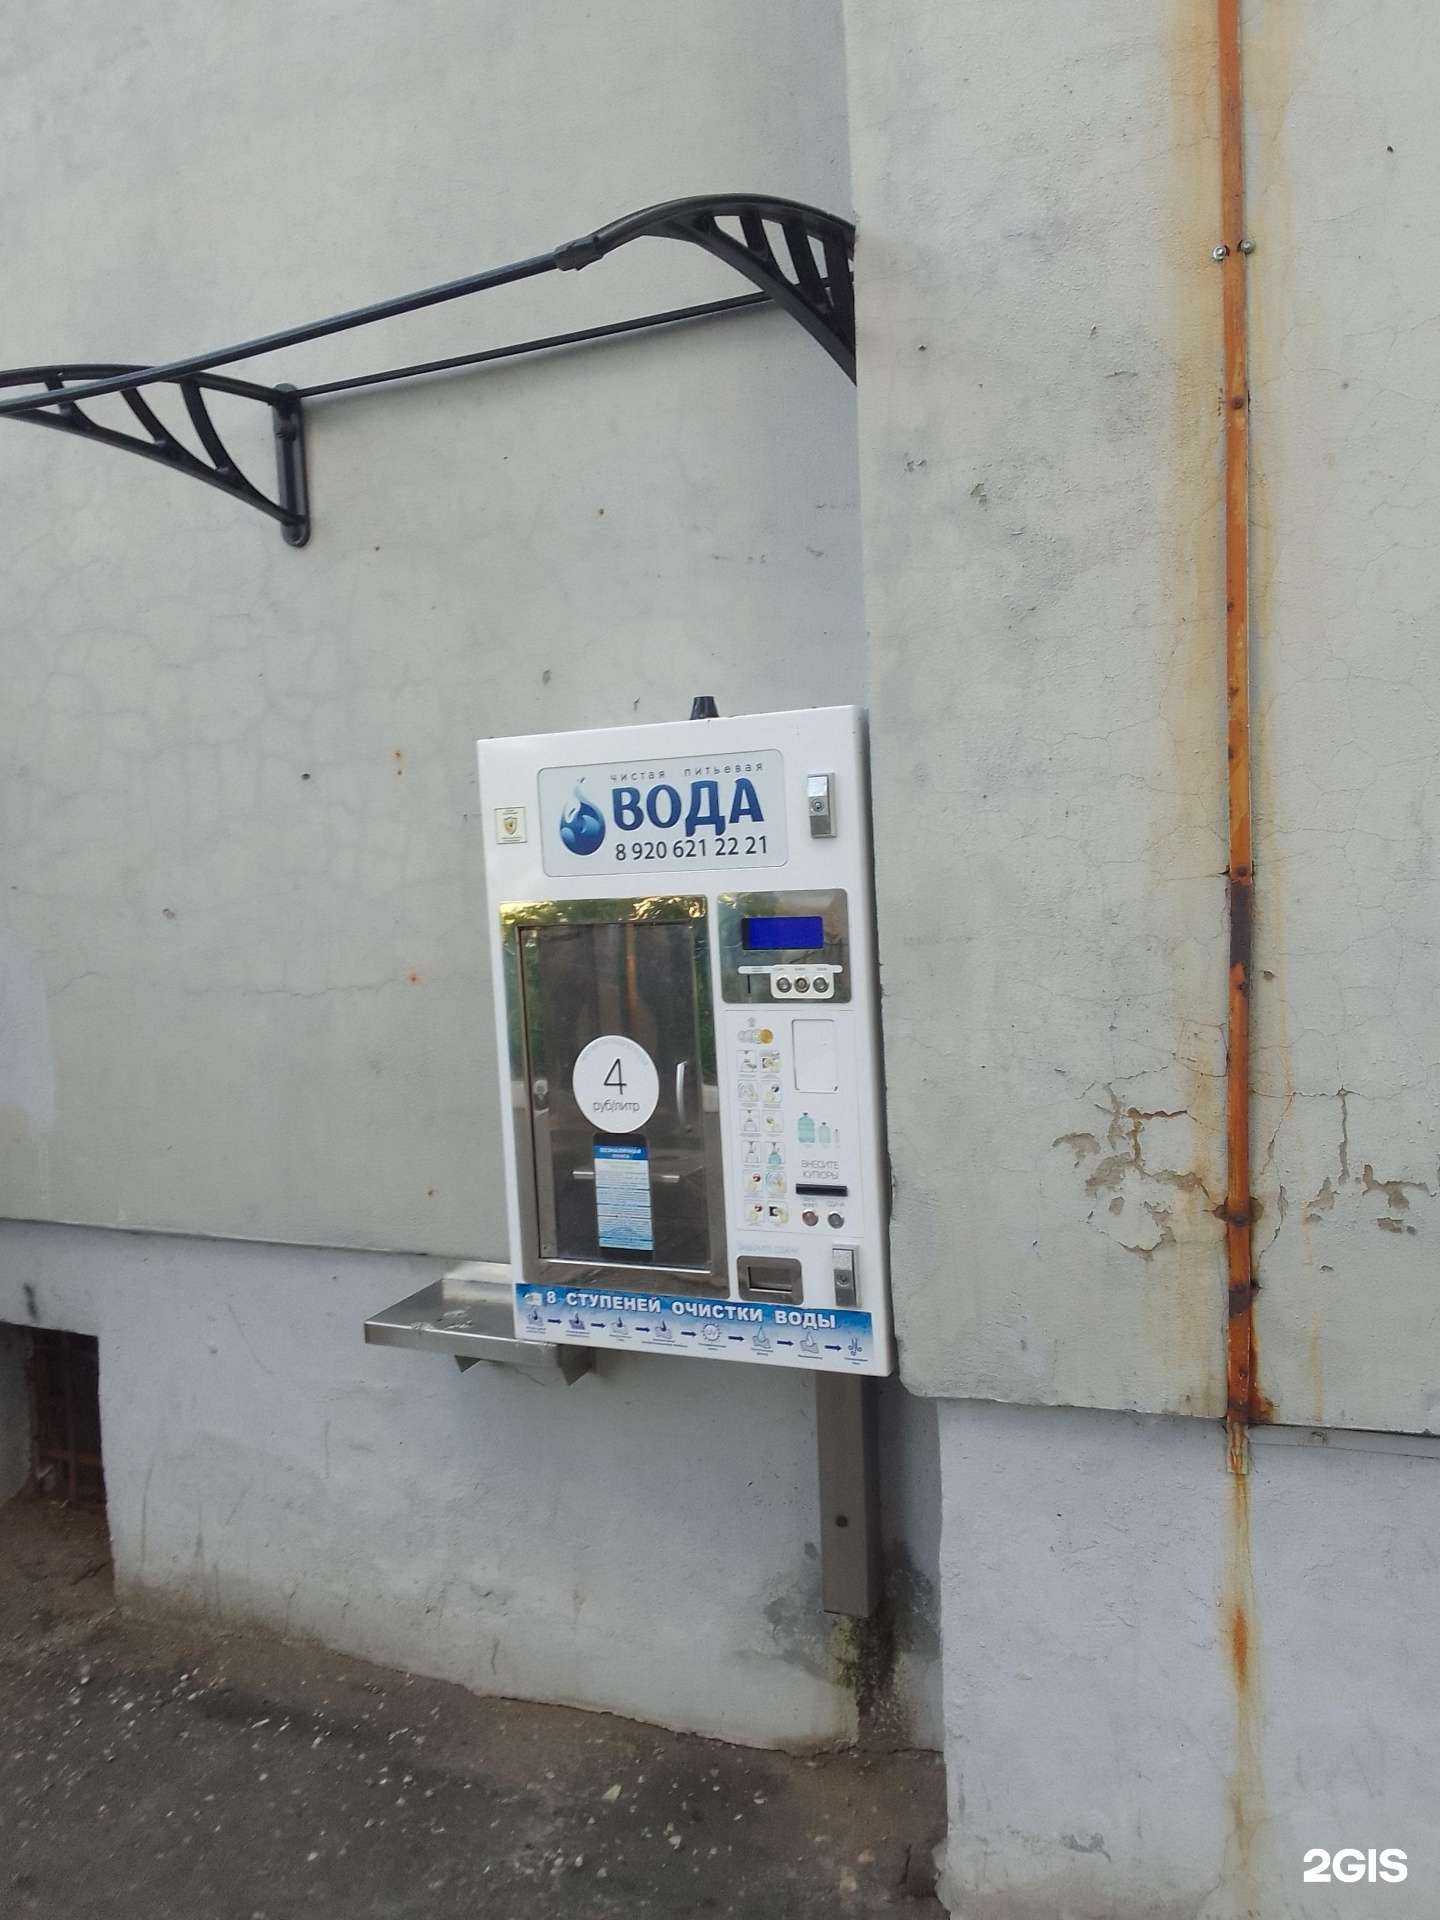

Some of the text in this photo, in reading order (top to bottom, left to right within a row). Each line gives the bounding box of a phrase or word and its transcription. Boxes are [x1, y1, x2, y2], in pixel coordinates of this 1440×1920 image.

[610, 762, 764, 784] чистая питьевая
[612, 777, 765, 838] ВОДА
[615, 834, 768, 861] 8 920 621 22 21
[603, 1058, 628, 1096] 4
[546, 1290, 836, 1330] 8 СТУПЕНЕЙ ОЧИСТКИ ВОДЫ
